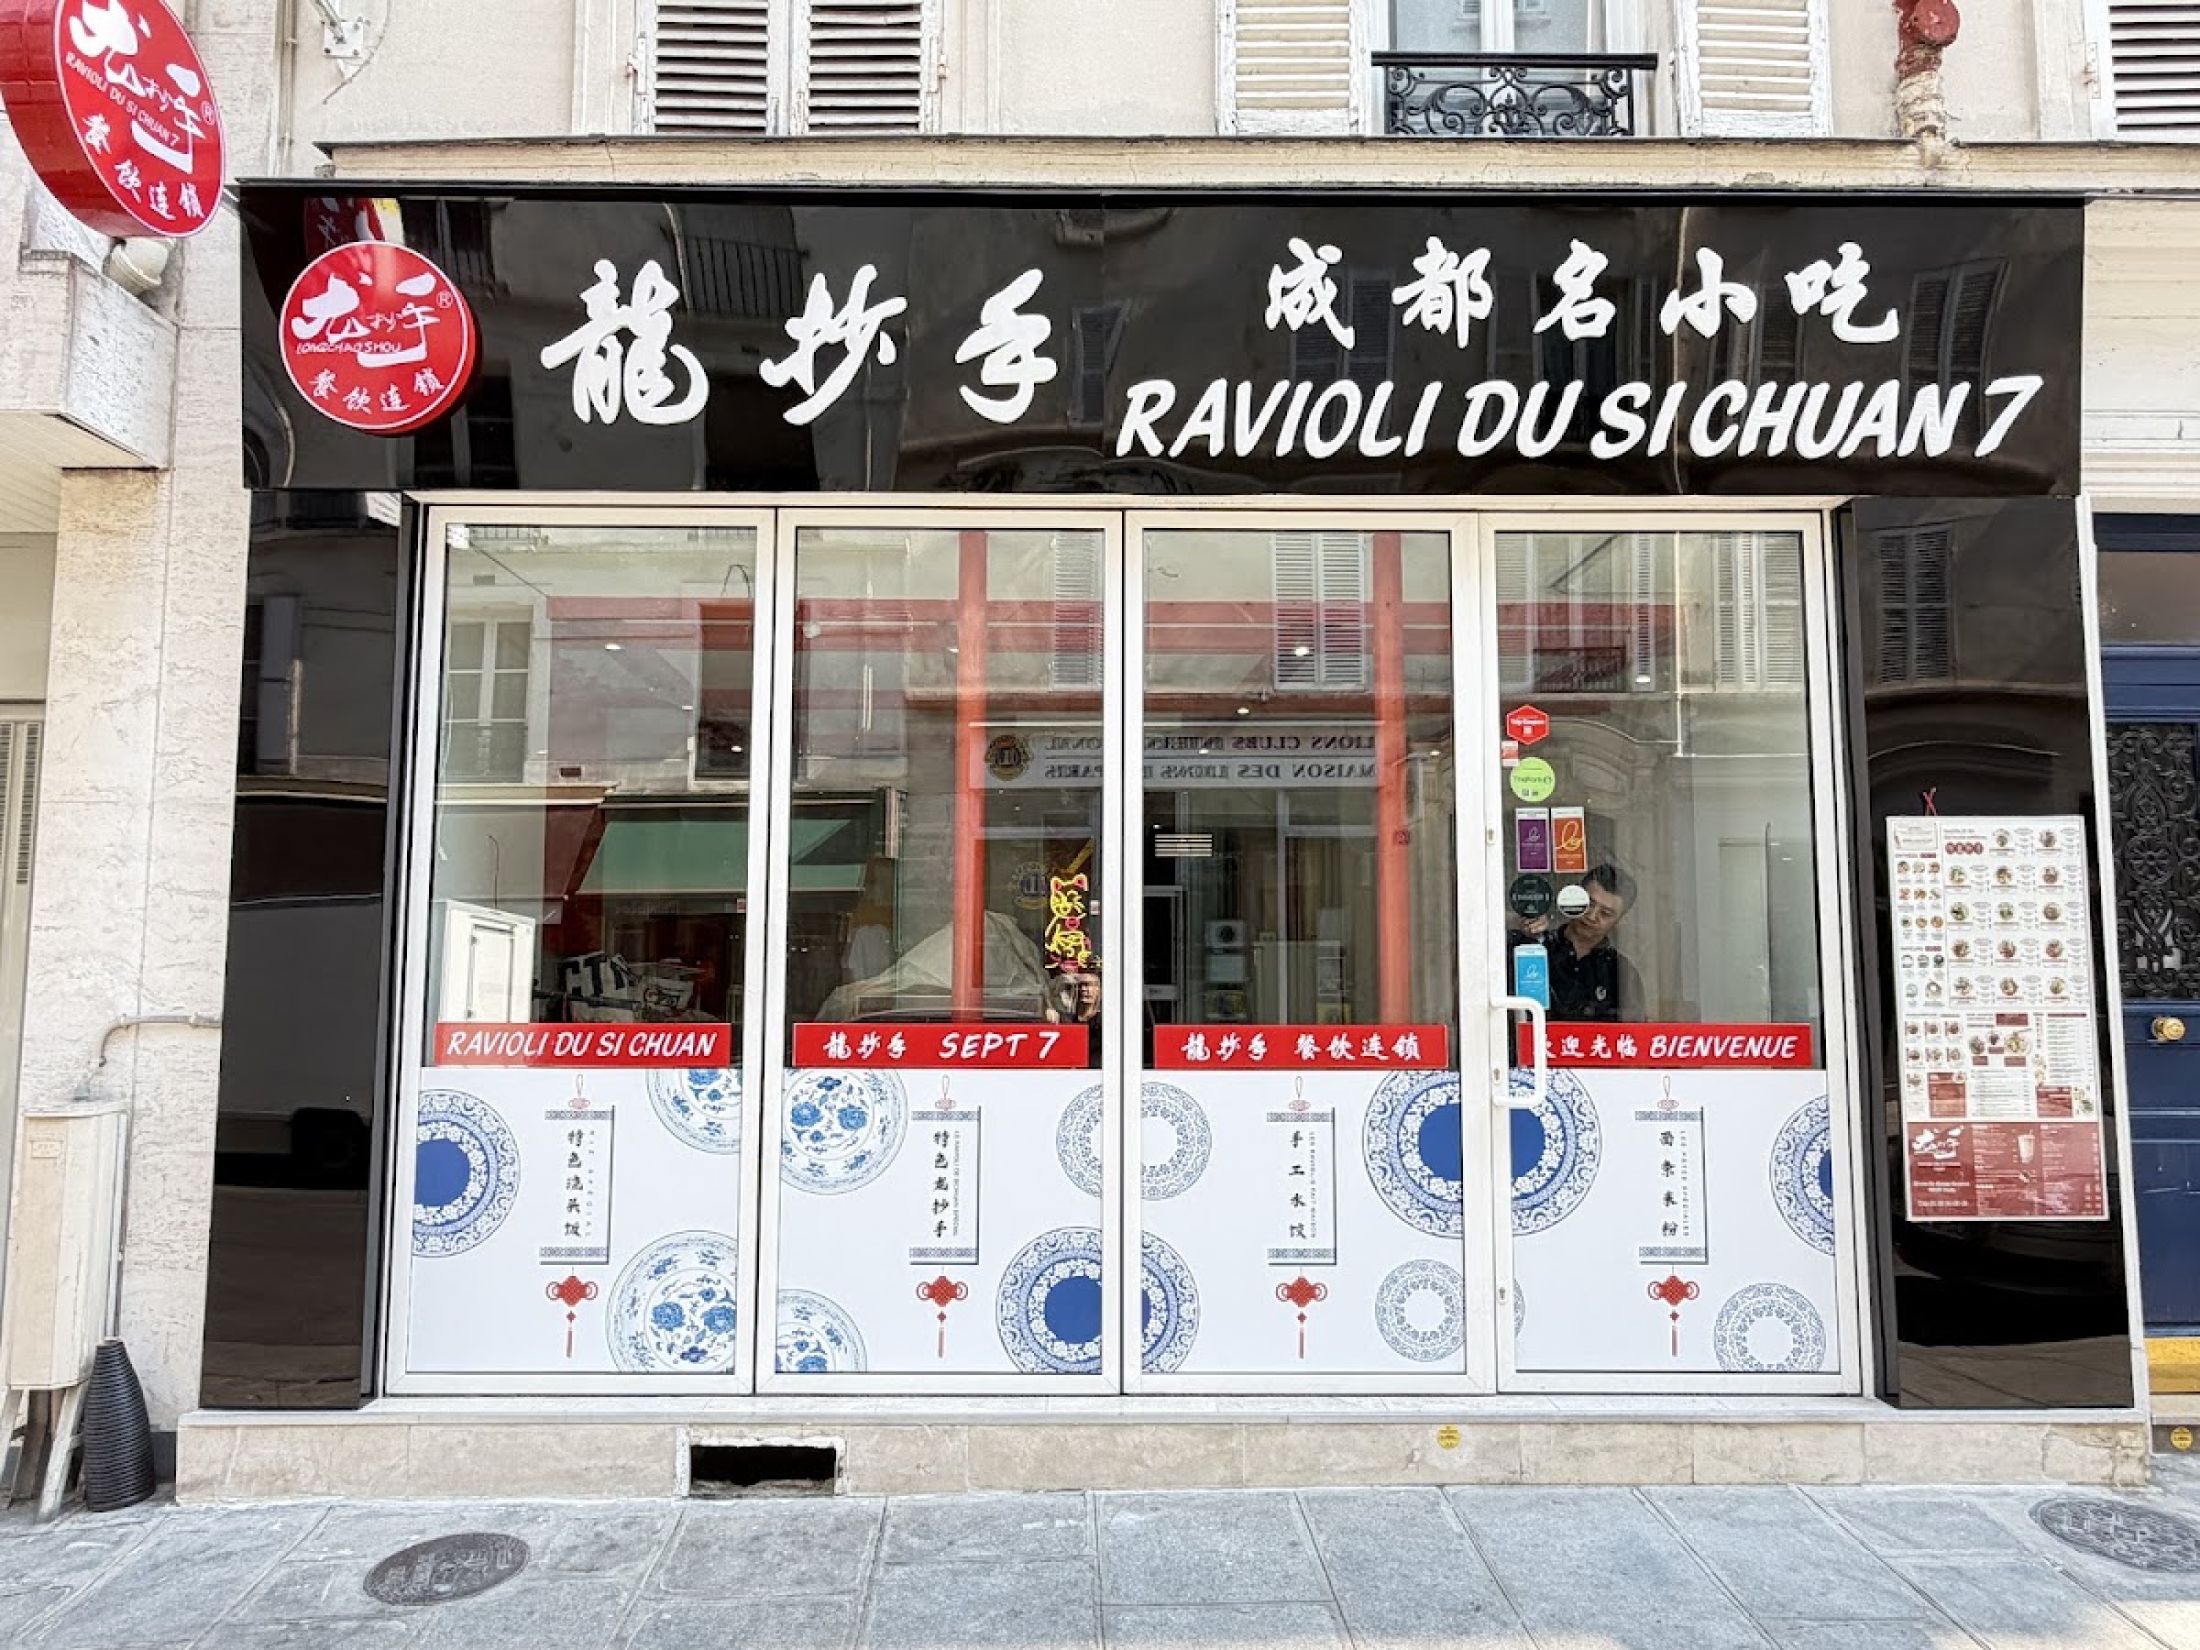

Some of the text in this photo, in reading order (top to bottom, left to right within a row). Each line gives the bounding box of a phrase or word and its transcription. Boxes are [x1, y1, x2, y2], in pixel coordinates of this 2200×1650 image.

[65, 51, 107, 92] RAVIOLI
[109, 88, 126, 106] DU
[137, 110, 170, 140] CHUAN
[168, 135, 179, 147] 7
[1265, 236, 1900, 350] 成都名小吃
[540, 259, 1057, 425] 龍抄手
[1116, 376, 2043, 458] RAVIOLI DU SI CHUAN 7
[447, 1031, 717, 1057] RAVIOLI DU SI CHUAN
[939, 1031, 1060, 1059] SEPT 7
[1649, 1035, 1797, 1059] BIENVENUE
[1288, 1130, 1307, 1239] 手工水饺
